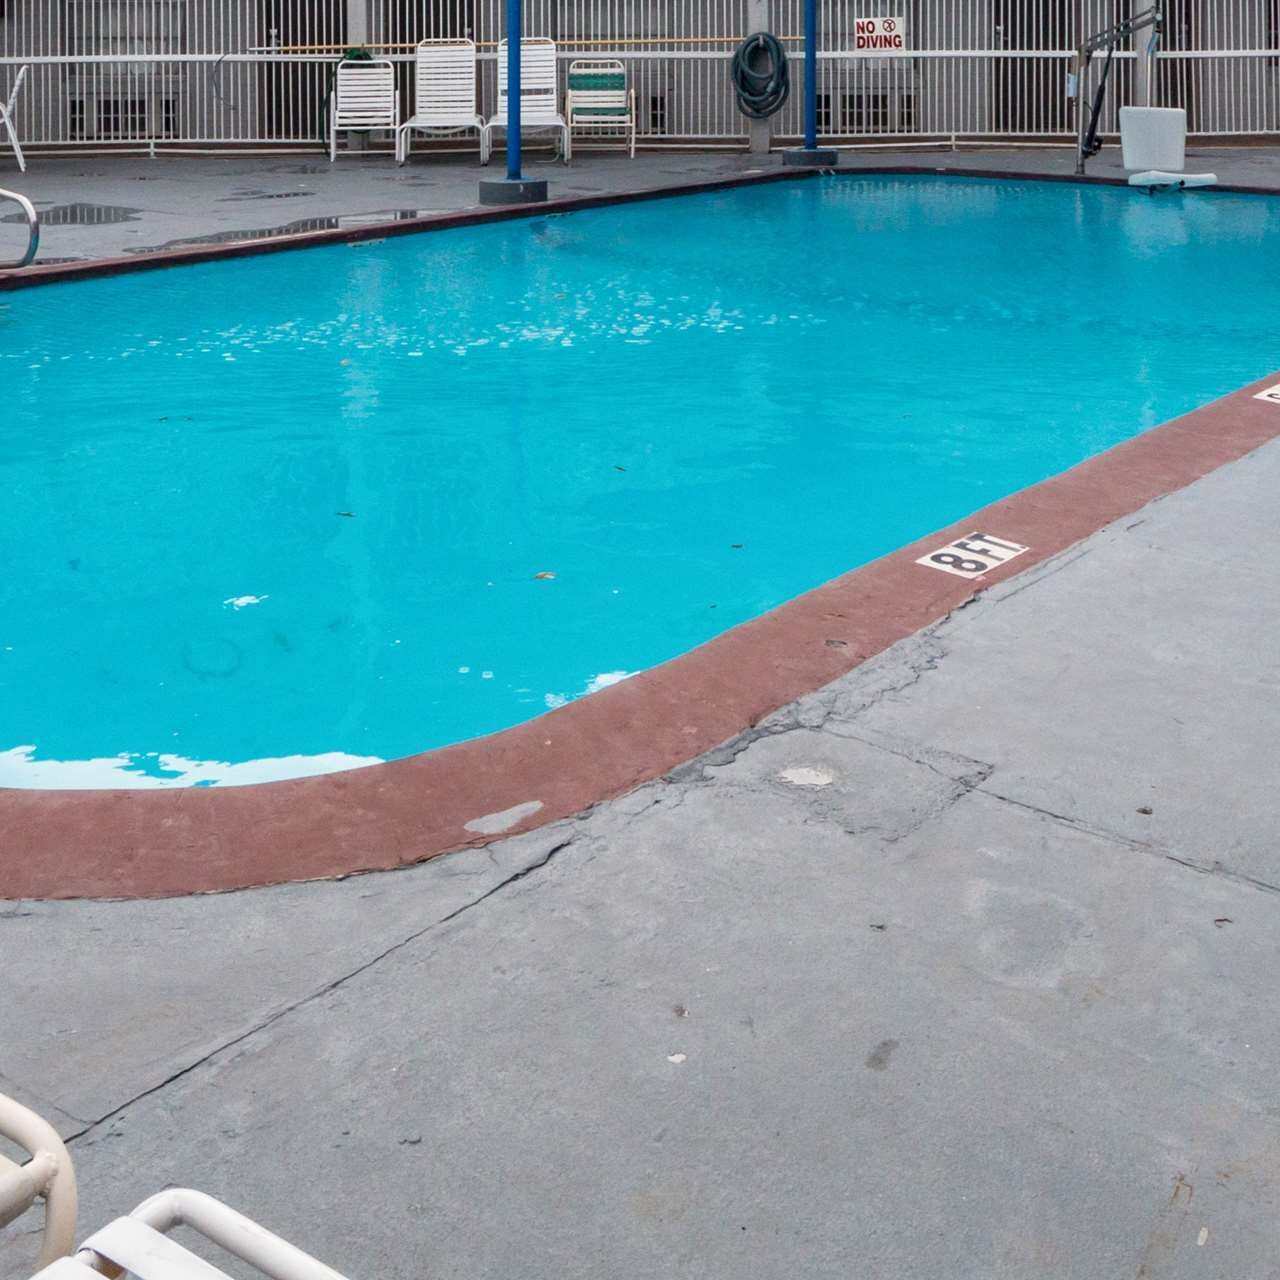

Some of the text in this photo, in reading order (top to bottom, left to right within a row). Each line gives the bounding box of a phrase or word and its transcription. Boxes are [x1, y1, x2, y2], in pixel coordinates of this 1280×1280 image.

[856, 21, 875, 34] NO
[857, 34, 902, 49] DIVING
[930, 533, 1021, 573] 8 FT
